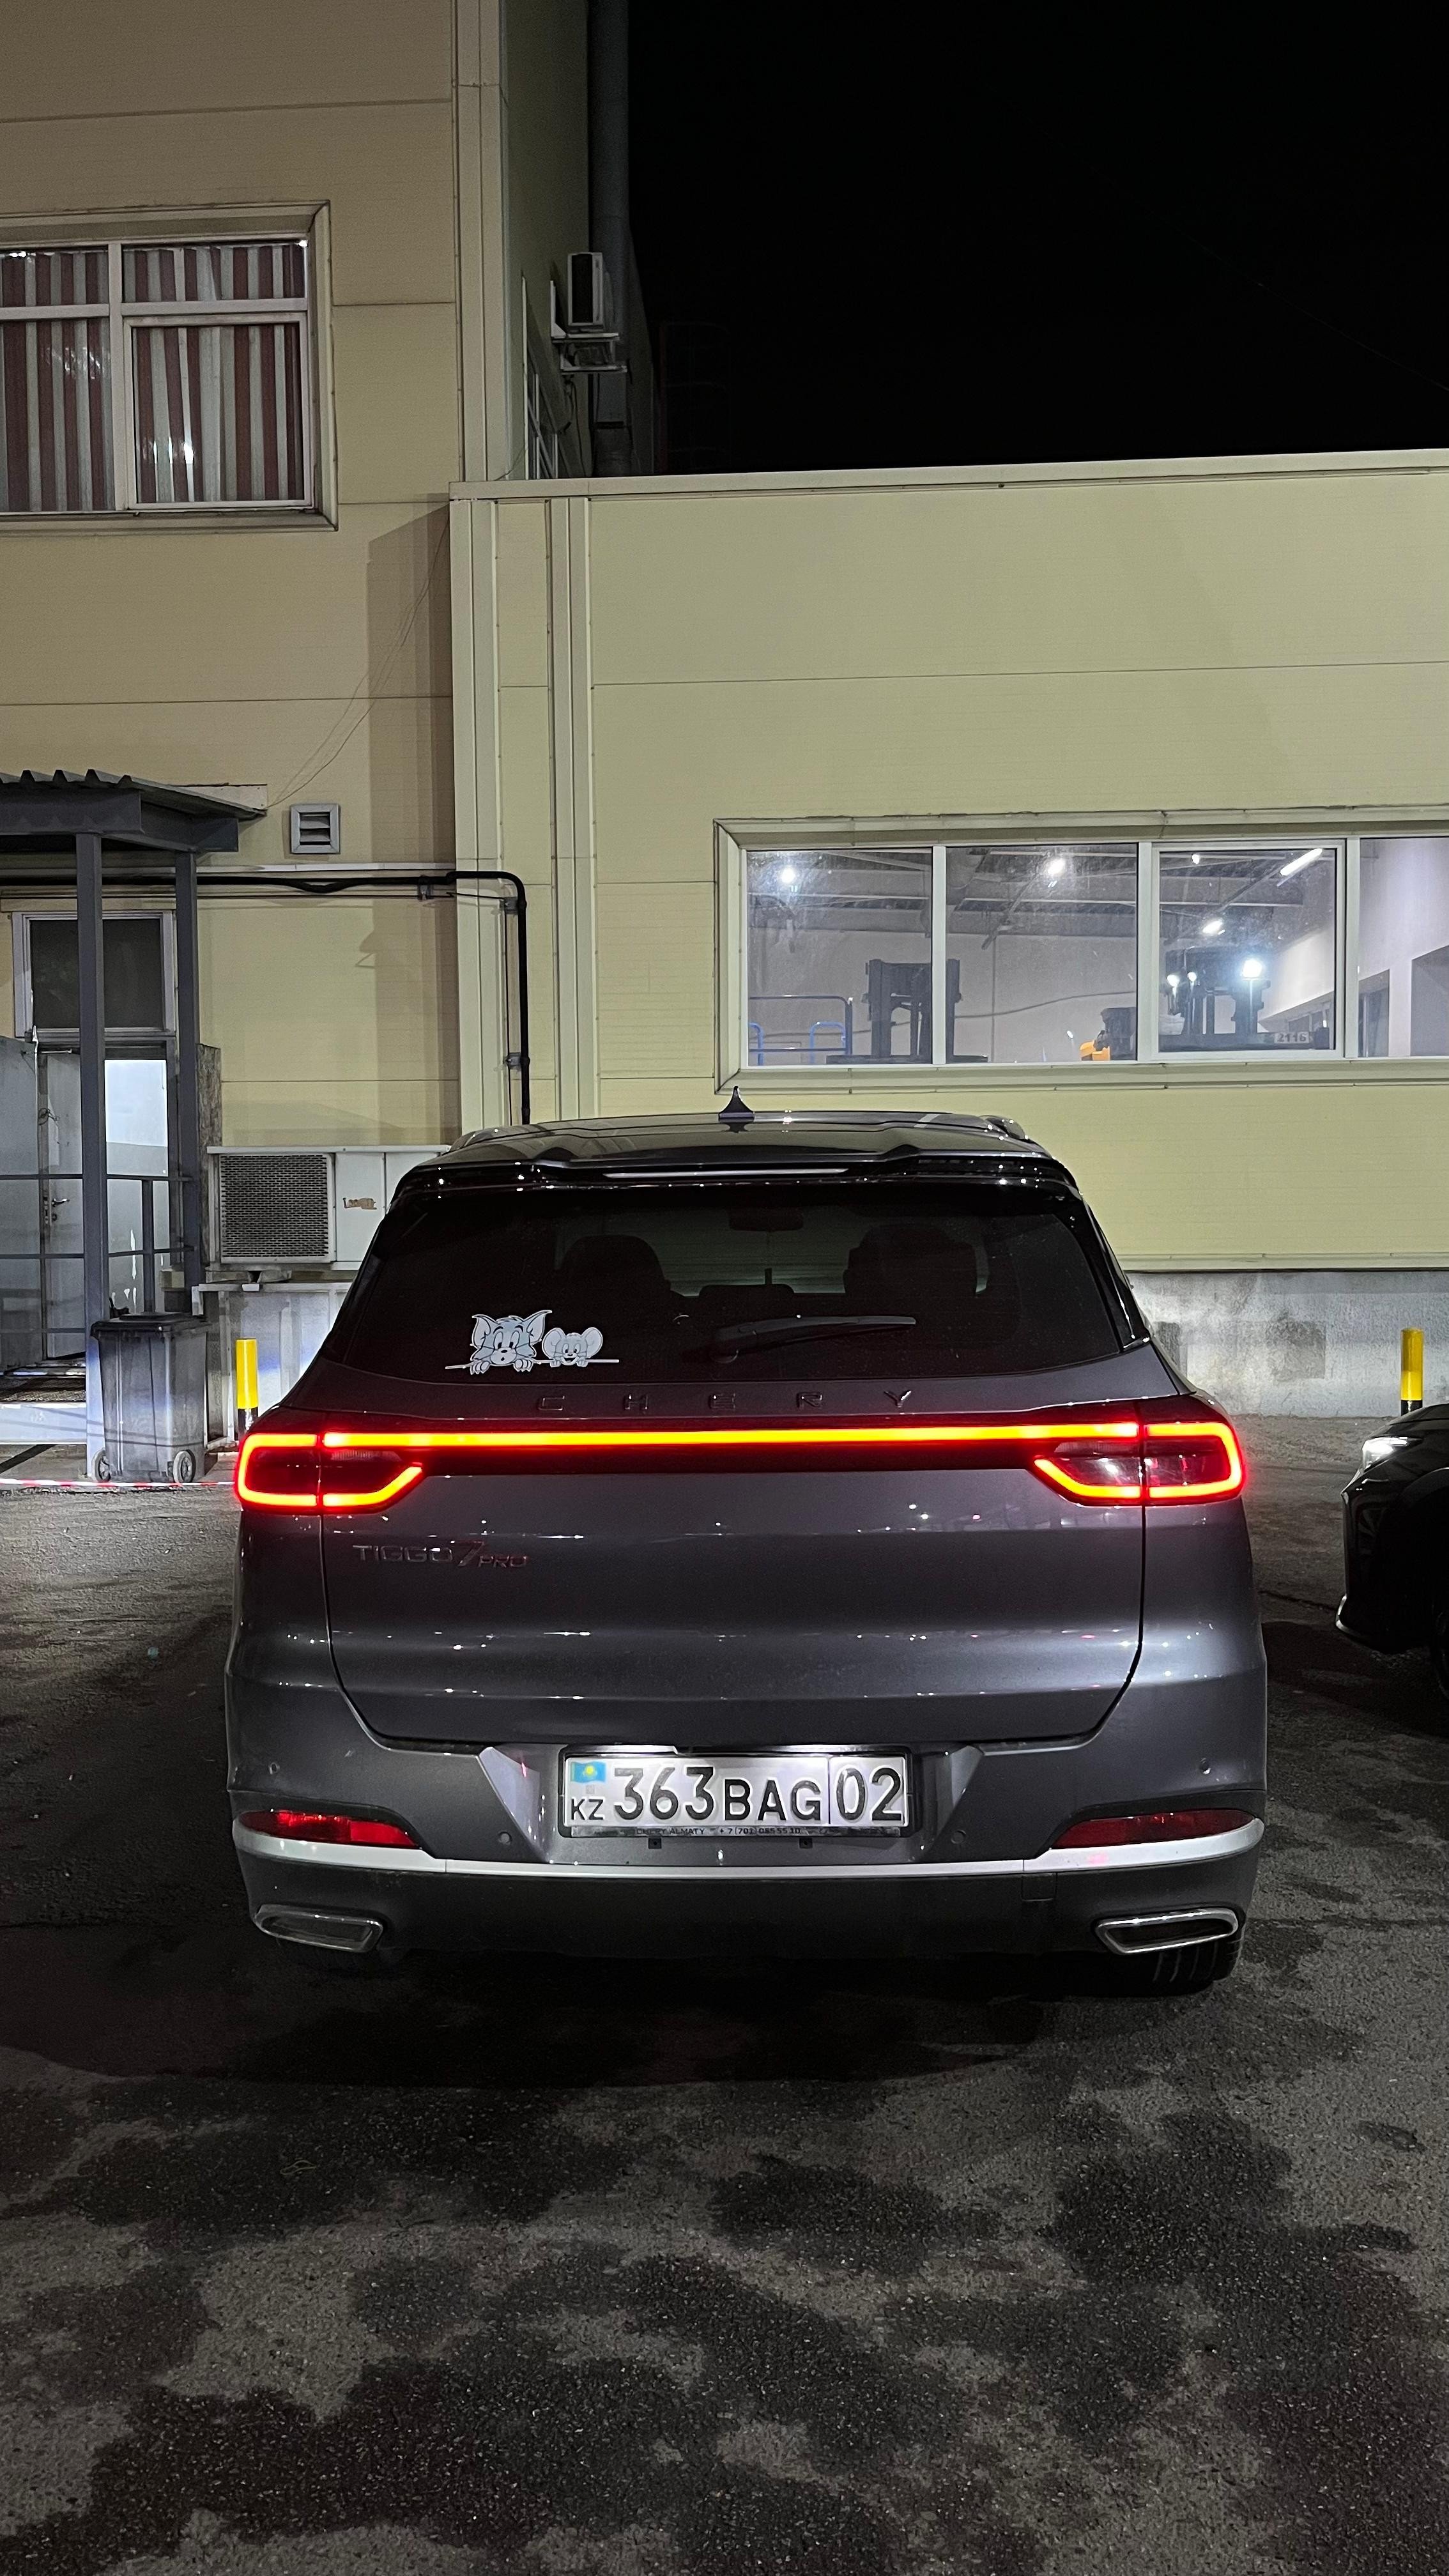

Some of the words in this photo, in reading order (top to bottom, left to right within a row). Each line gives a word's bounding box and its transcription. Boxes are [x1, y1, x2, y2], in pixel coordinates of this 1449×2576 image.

[537, 1390, 912, 1411] CHERY
[352, 1545, 453, 1562] TIGGO
[450, 1540, 485, 1567] 7
[479, 1555, 530, 1567] PRO
[571, 1798, 604, 1821] KZ
[836, 1767, 901, 1821] 02
